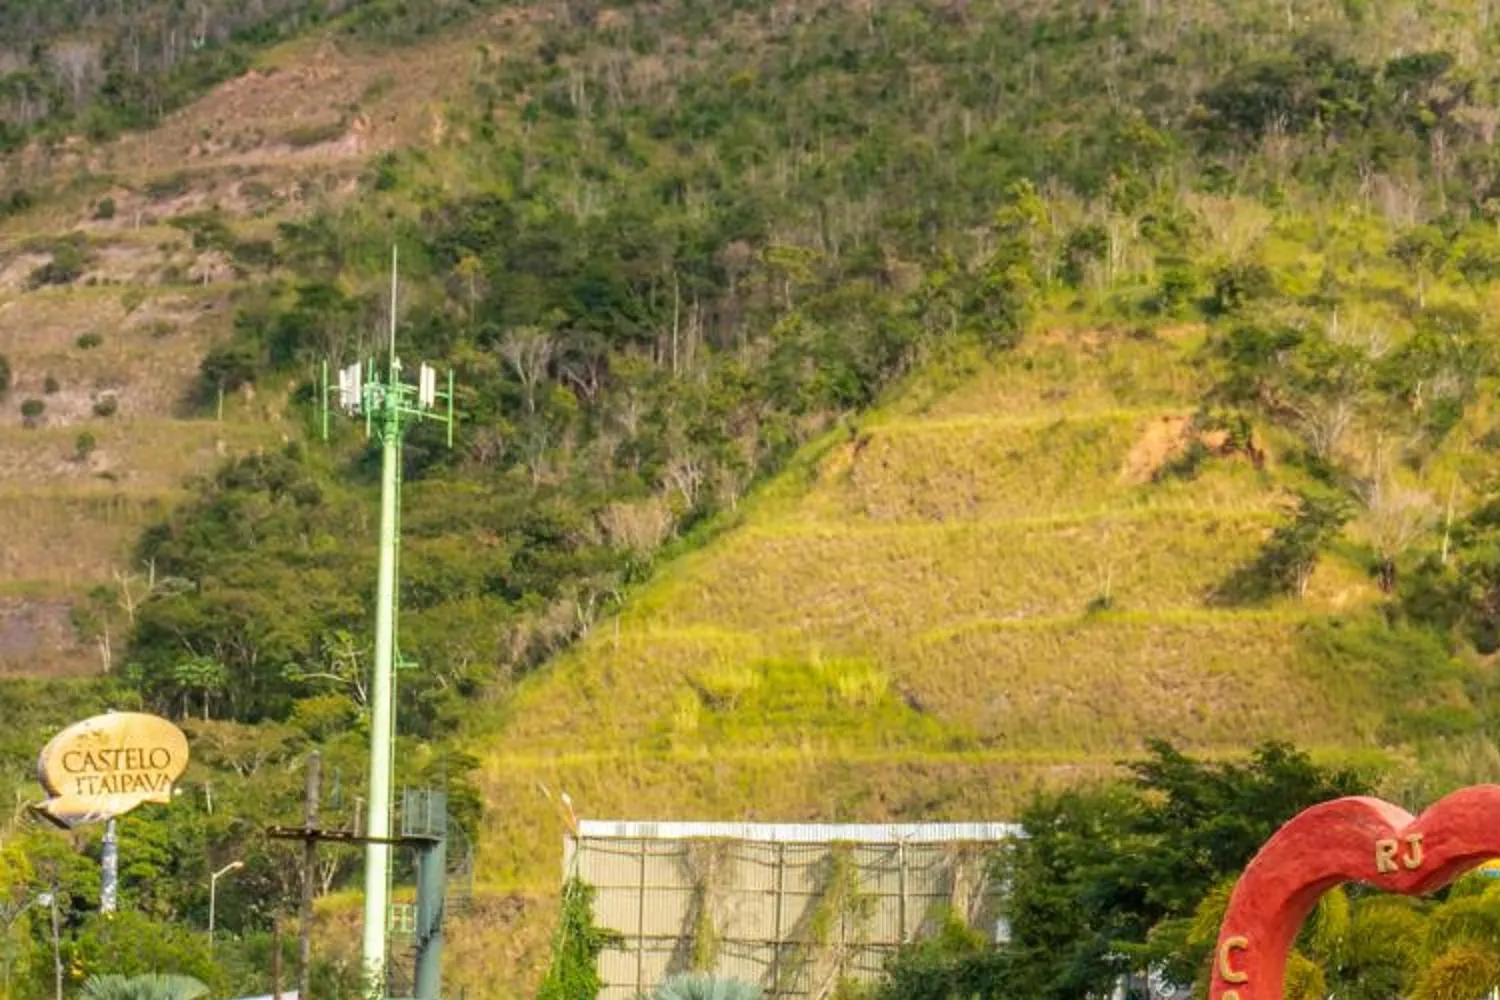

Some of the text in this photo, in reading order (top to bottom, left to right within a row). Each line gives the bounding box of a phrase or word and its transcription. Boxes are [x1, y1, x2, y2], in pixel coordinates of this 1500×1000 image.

[62, 747, 171, 773] CASTELO
[76, 772, 171, 795] ITAIPAVA
[1375, 833, 1424, 874] RJ
